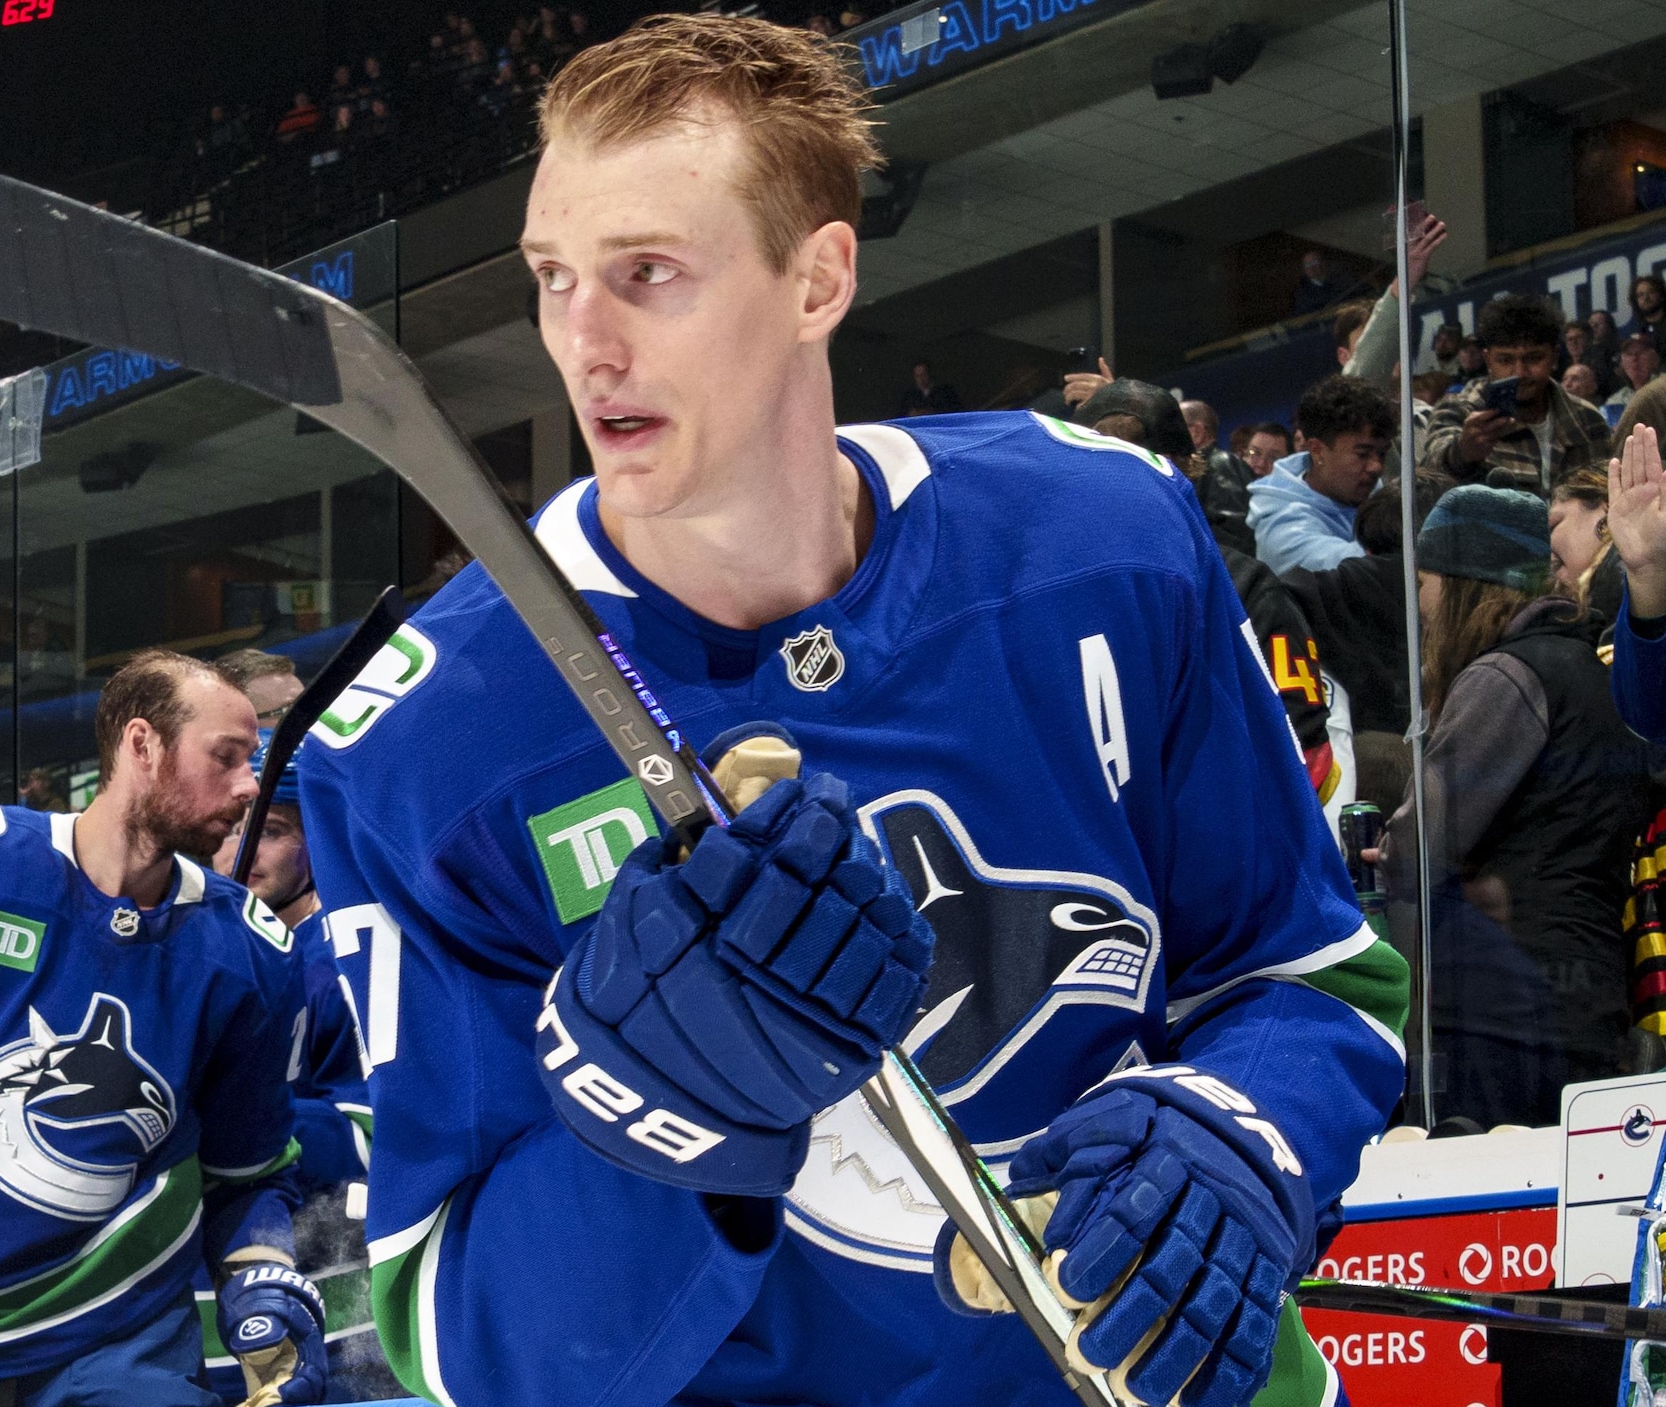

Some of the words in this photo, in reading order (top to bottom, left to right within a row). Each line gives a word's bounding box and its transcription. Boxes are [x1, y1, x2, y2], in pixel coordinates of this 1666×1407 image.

[1271, 634, 1327, 705] 4
[1079, 633, 1132, 803] A
[548, 807, 659, 890] TD
[536, 1000, 728, 1164] BAU
[1317, 1251, 1426, 1286] OGERS
[1317, 1330, 1426, 1366] OGERS
